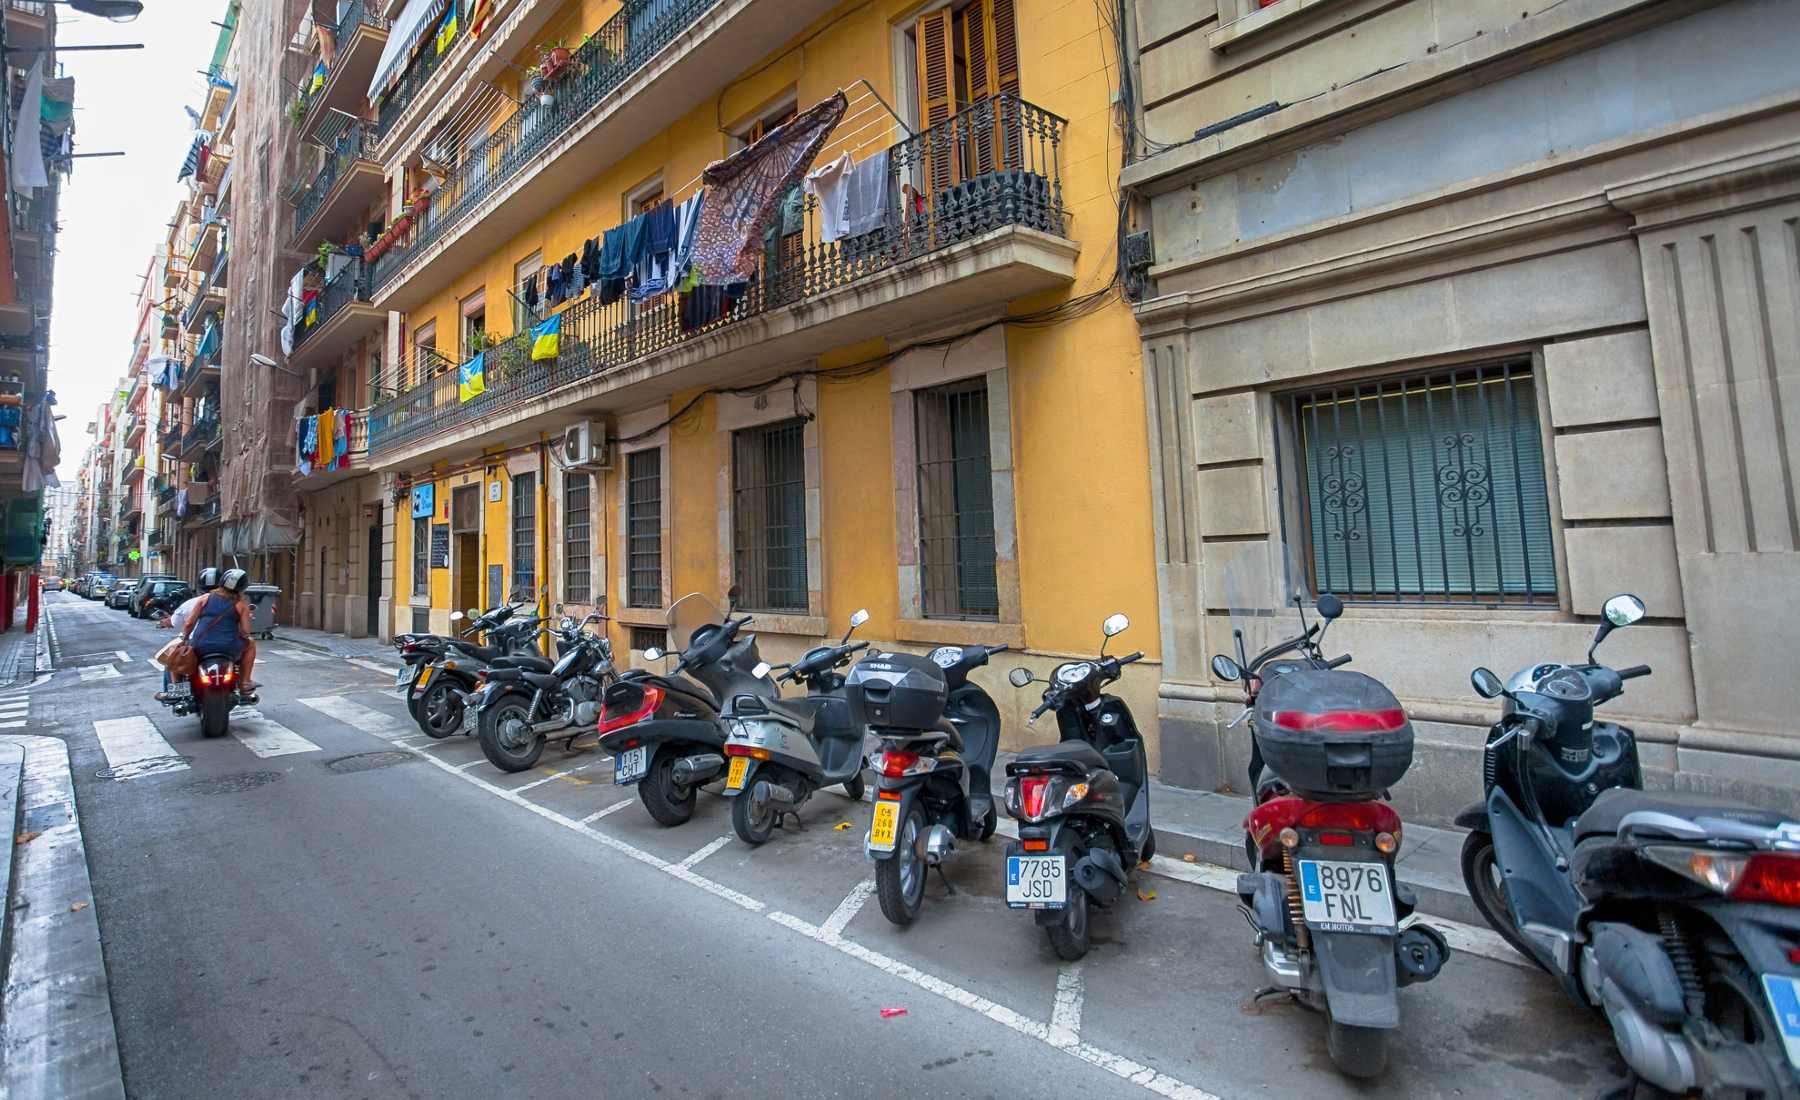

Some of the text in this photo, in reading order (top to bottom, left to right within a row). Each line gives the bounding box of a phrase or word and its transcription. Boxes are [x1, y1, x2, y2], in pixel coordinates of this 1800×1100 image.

[623, 762, 638, 776] CHT
[1021, 860, 1061, 878] 7785
[1321, 866, 1382, 892] 8976
[1023, 879, 1053, 898] JSD
[1308, 885, 1316, 895] E
[1325, 893, 1372, 920] FNL
